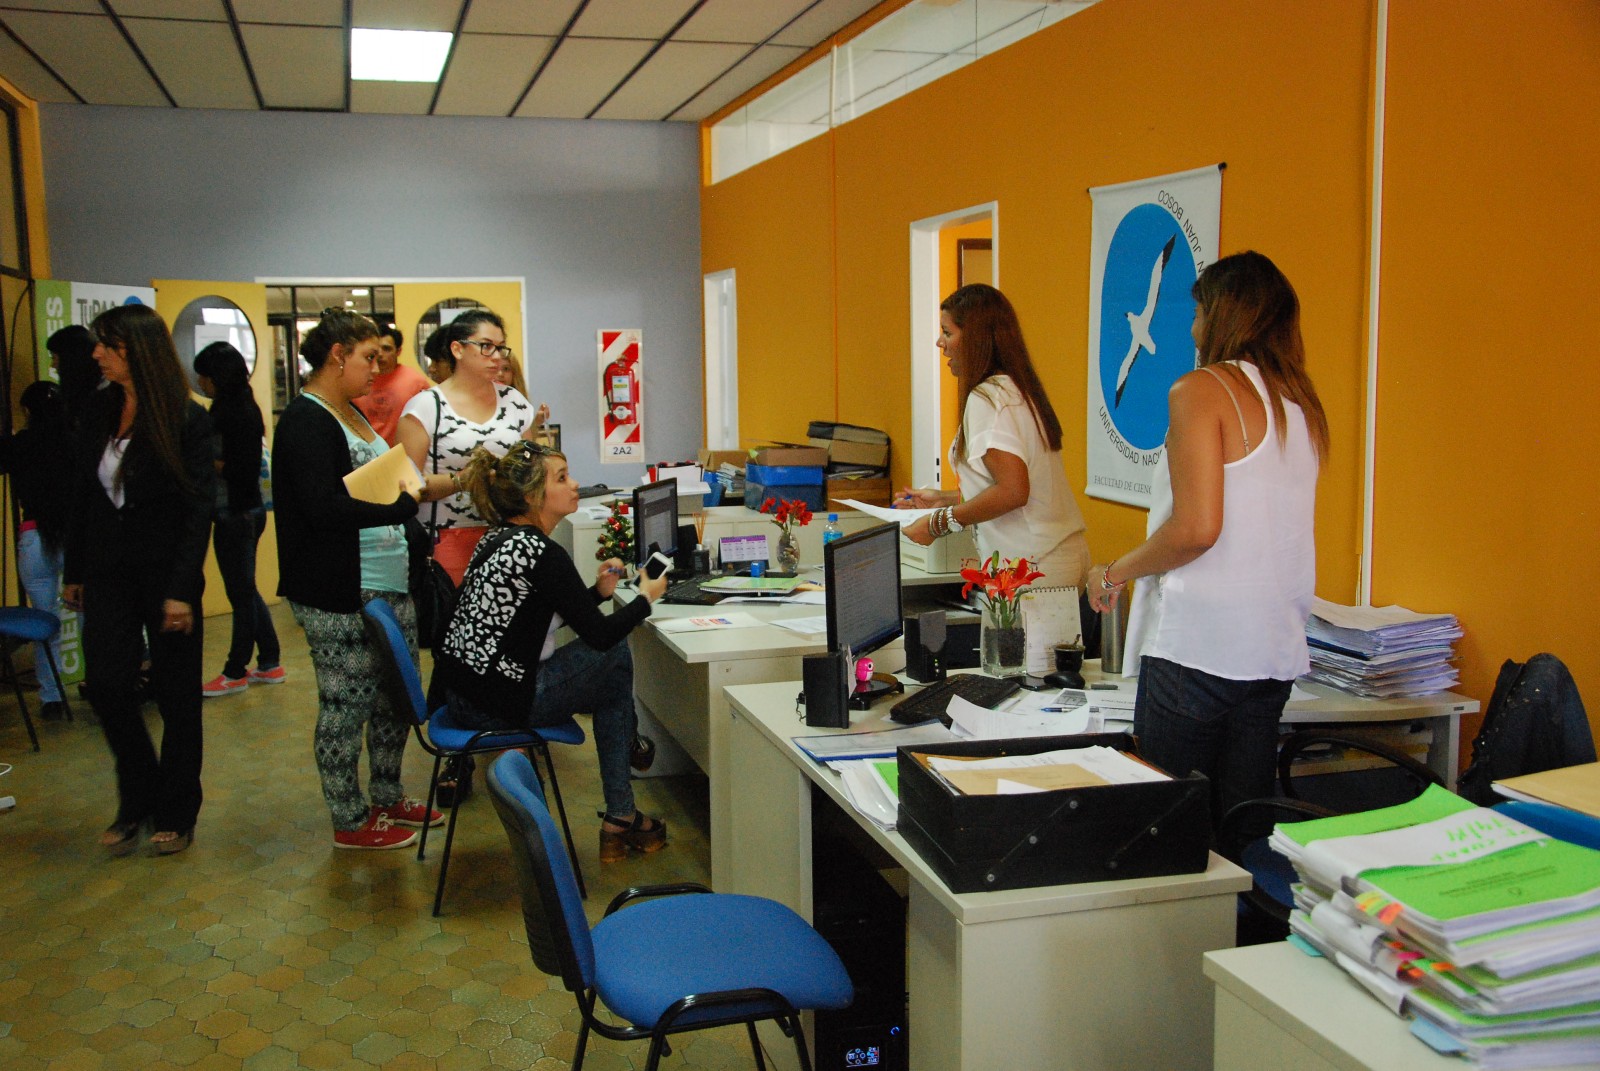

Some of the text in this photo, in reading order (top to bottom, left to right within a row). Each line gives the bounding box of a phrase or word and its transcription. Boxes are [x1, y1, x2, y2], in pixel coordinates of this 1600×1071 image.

[1158, 190, 1184, 220] BOSCO
[1183, 218, 1202, 252] JUAN
[1099, 406, 1140, 464] UNIVERSIDAD
[613, 446, 632, 455] 2A2
[1094, 475, 1123, 489] FACULTAD
[1124, 480, 1133, 491] DE
